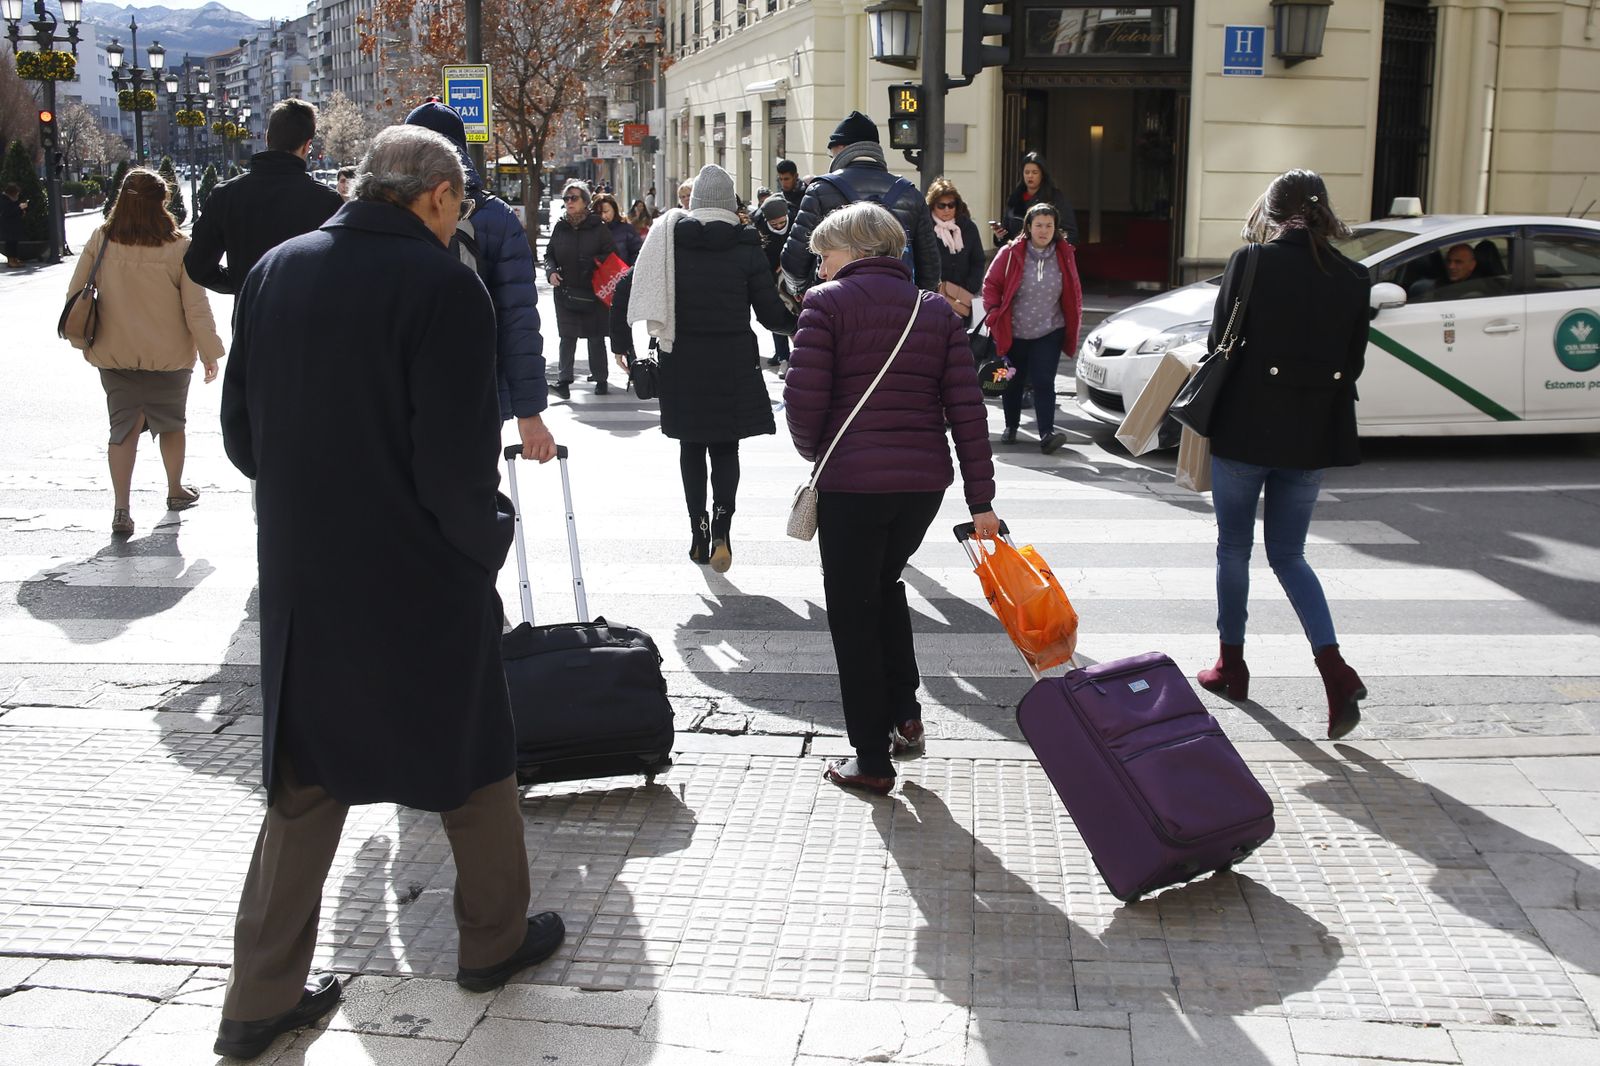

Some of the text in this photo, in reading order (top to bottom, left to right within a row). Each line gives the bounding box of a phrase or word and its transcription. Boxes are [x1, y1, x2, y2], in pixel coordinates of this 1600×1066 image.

[1234, 30, 1255, 53] H
[901, 90, 917, 112] 16
[455, 106, 479, 117] TAXI
[1545, 380, 1585, 389] Estamos
